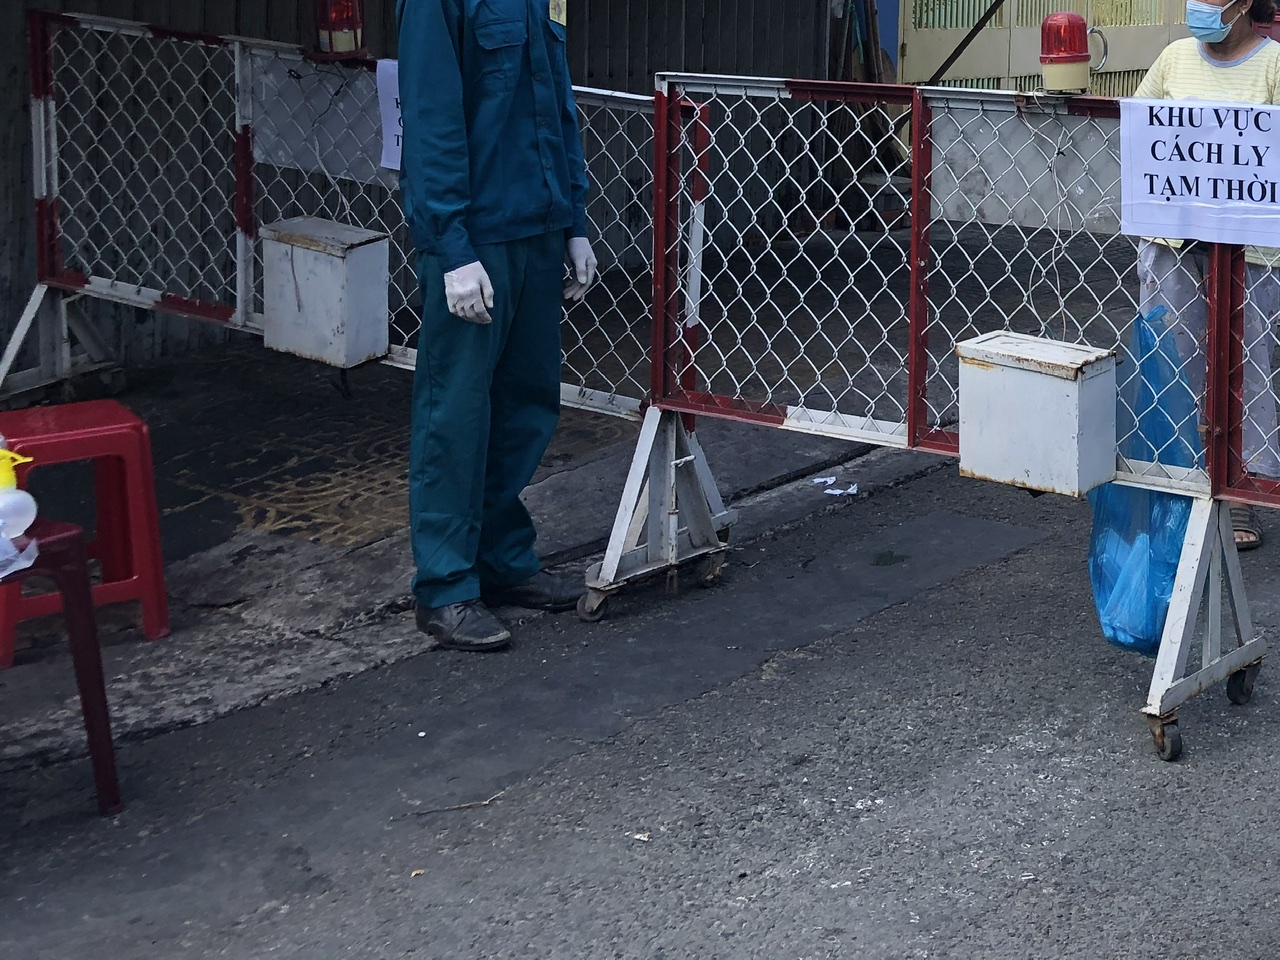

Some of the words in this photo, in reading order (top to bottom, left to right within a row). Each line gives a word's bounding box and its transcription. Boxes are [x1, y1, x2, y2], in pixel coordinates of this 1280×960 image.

[1147, 105, 1204, 128] KHU
[1212, 107, 1272, 137] VỰC
[1150, 134, 1224, 164] CÁCH
[1232, 144, 1270, 167] LY
[1143, 173, 1201, 202] TẠM
[1207, 173, 1279, 203] THỜI
